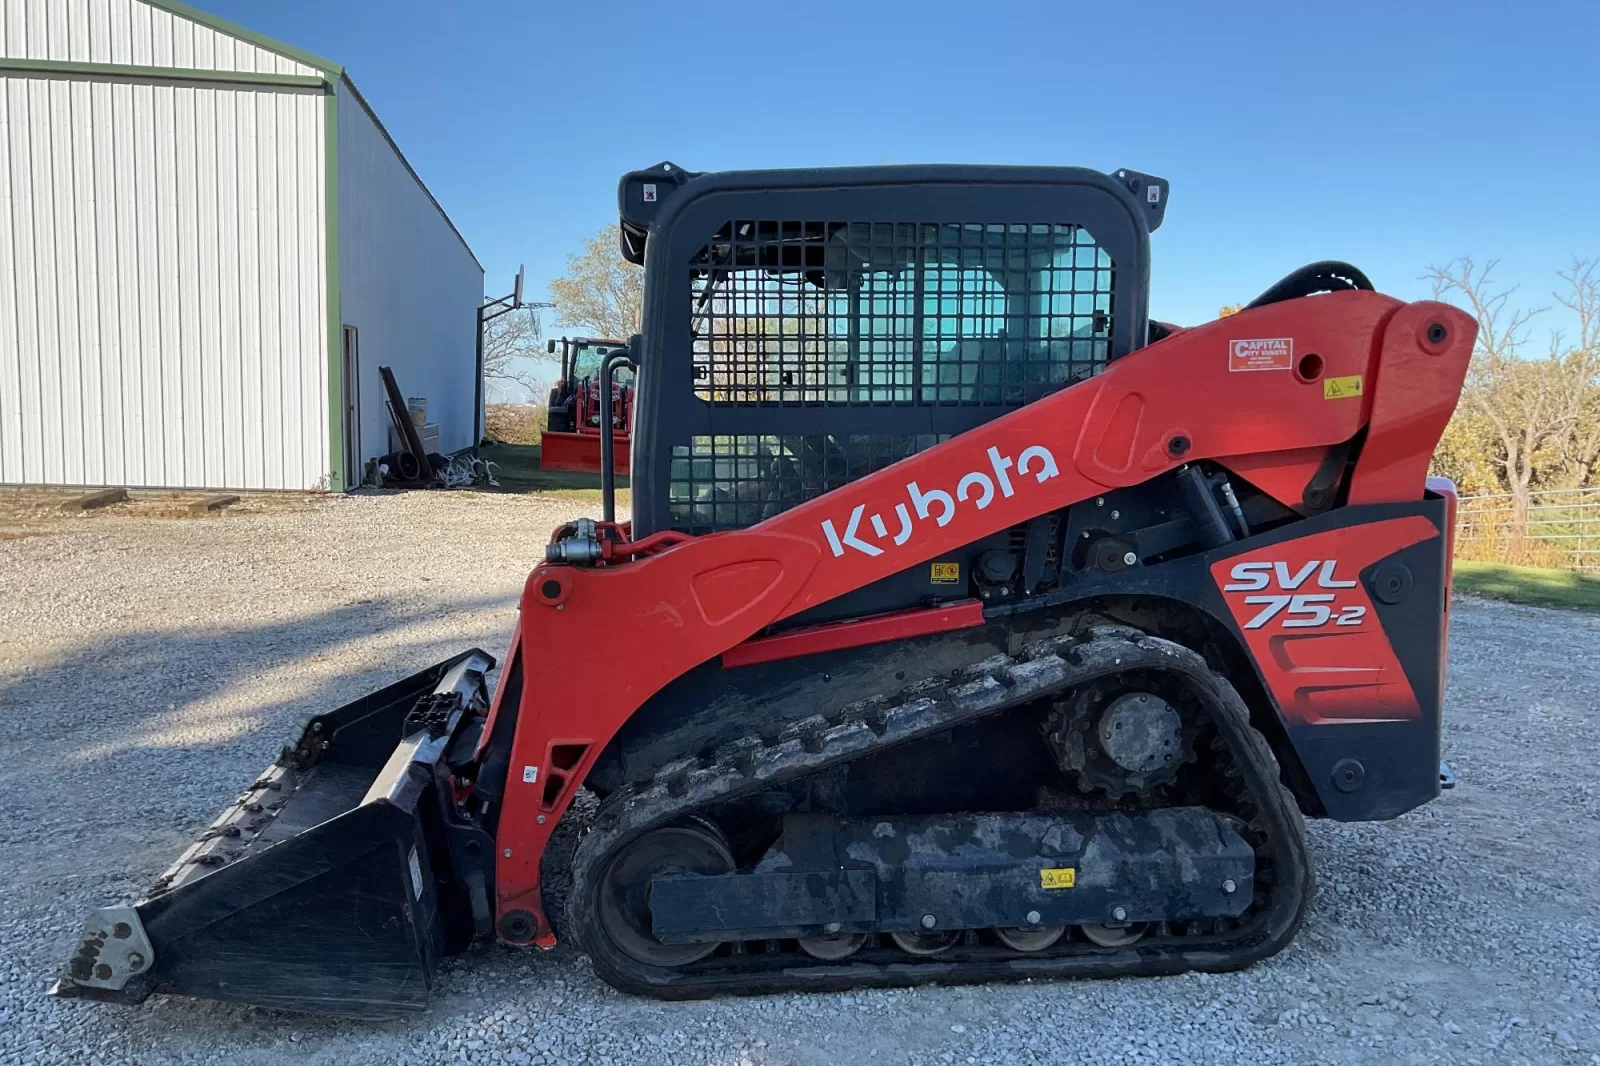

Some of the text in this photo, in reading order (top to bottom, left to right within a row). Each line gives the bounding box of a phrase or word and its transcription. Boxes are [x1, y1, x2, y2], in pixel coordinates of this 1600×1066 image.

[1235, 341, 1287, 357] CAPITAL
[821, 445, 1060, 558] Kubota
[1223, 559, 1357, 591] SVL
[1243, 593, 1367, 629] 75-2
